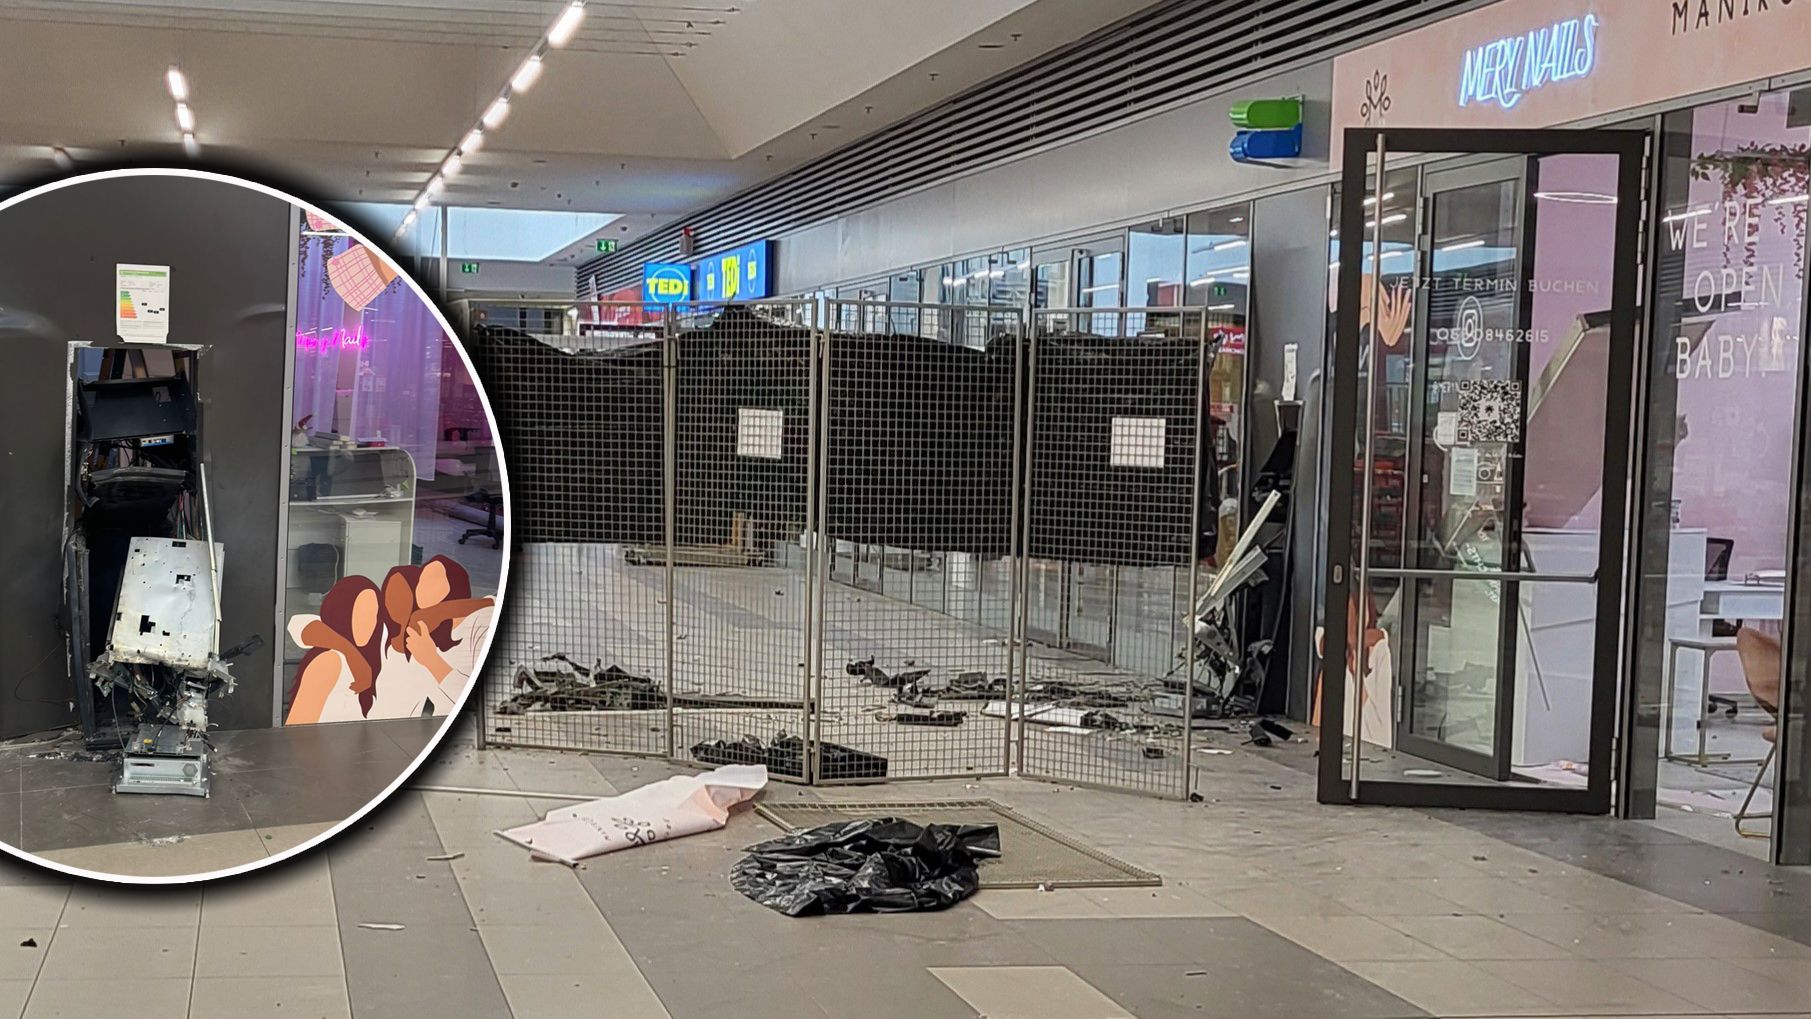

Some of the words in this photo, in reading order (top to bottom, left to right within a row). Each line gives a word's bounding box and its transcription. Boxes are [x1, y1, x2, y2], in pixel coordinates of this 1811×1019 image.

[1459, 36, 1525, 108] MERY
[1521, 14, 1599, 89] NAILS
[1668, 198, 1760, 251] WE'RE
[1389, 276, 1442, 291] JETZT
[1452, 277, 1518, 292] TERMIN
[1527, 278, 1600, 294] BUCHEN
[1694, 263, 1785, 313] OPEN
